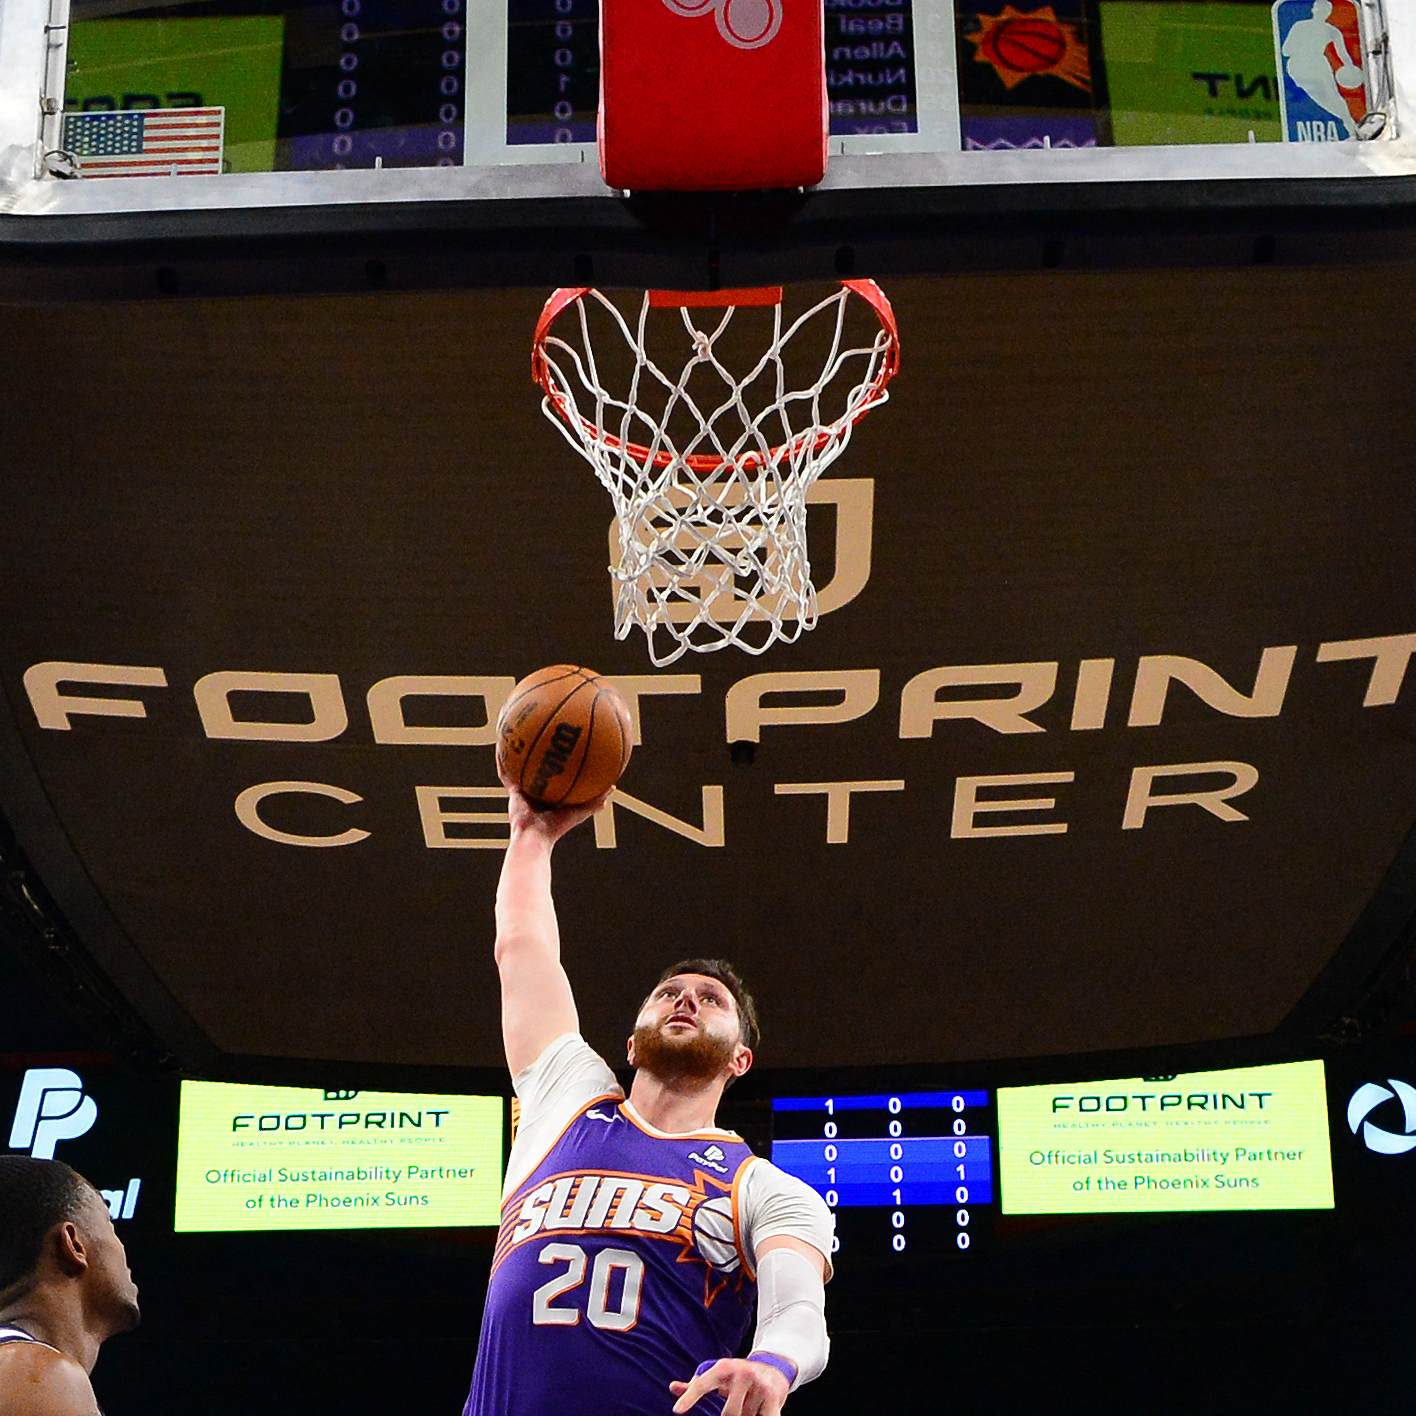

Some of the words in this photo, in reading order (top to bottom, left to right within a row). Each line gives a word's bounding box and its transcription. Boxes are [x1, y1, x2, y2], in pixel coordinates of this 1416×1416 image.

[1296, 121, 1340, 142] NBA
[235, 761, 1259, 849] CENTER
[824, 1098, 834, 1115] 1
[888, 1097, 902, 1114] 0
[951, 1095, 965, 1113] 0
[1052, 1092, 1273, 1114] FOOTPRINT
[232, 1110, 450, 1133] FOOTPRINT
[824, 1121, 837, 1138] 0
[888, 1120, 902, 1137] 0
[952, 1119, 966, 1136] 0
[824, 1144, 837, 1161] 0
[889, 1143, 903, 1160] 0
[953, 1141, 967, 1158] 0
[1029, 1150, 1098, 1166] Official
[1103, 1148, 1230, 1167] Sustainability
[1235, 1146, 1305, 1163] Partner
[688, 1151, 728, 1174] PayPal
[205, 1168, 274, 1185] Official
[278, 1165, 402, 1185] Sustainability
[407, 1164, 476, 1181] Partner
[826, 1167, 836, 1184] 1
[890, 1165, 903, 1183] 0
[955, 1163, 966, 1181] 1
[1072, 1176, 1091, 1192] of
[1097, 1175, 1128, 1191] the
[1133, 1174, 1211, 1190] Phoenix
[1214, 1173, 1260, 1189] Suns
[245, 1194, 264, 1210] of
[269, 1194, 301, 1209] the
[305, 1192, 380, 1208] Phoenix
[384, 1191, 430, 1207] Suns
[825, 1190, 839, 1207] 0
[892, 1188, 902, 1205] 1
[955, 1186, 969, 1204] 0
[512, 1176, 693, 1245] SUNS
[891, 1211, 905, 1228] 0
[956, 1209, 970, 1226] 0
[892, 1234, 906, 1251] 0
[957, 1232, 971, 1249] 0
[533, 1242, 645, 1332] 20
